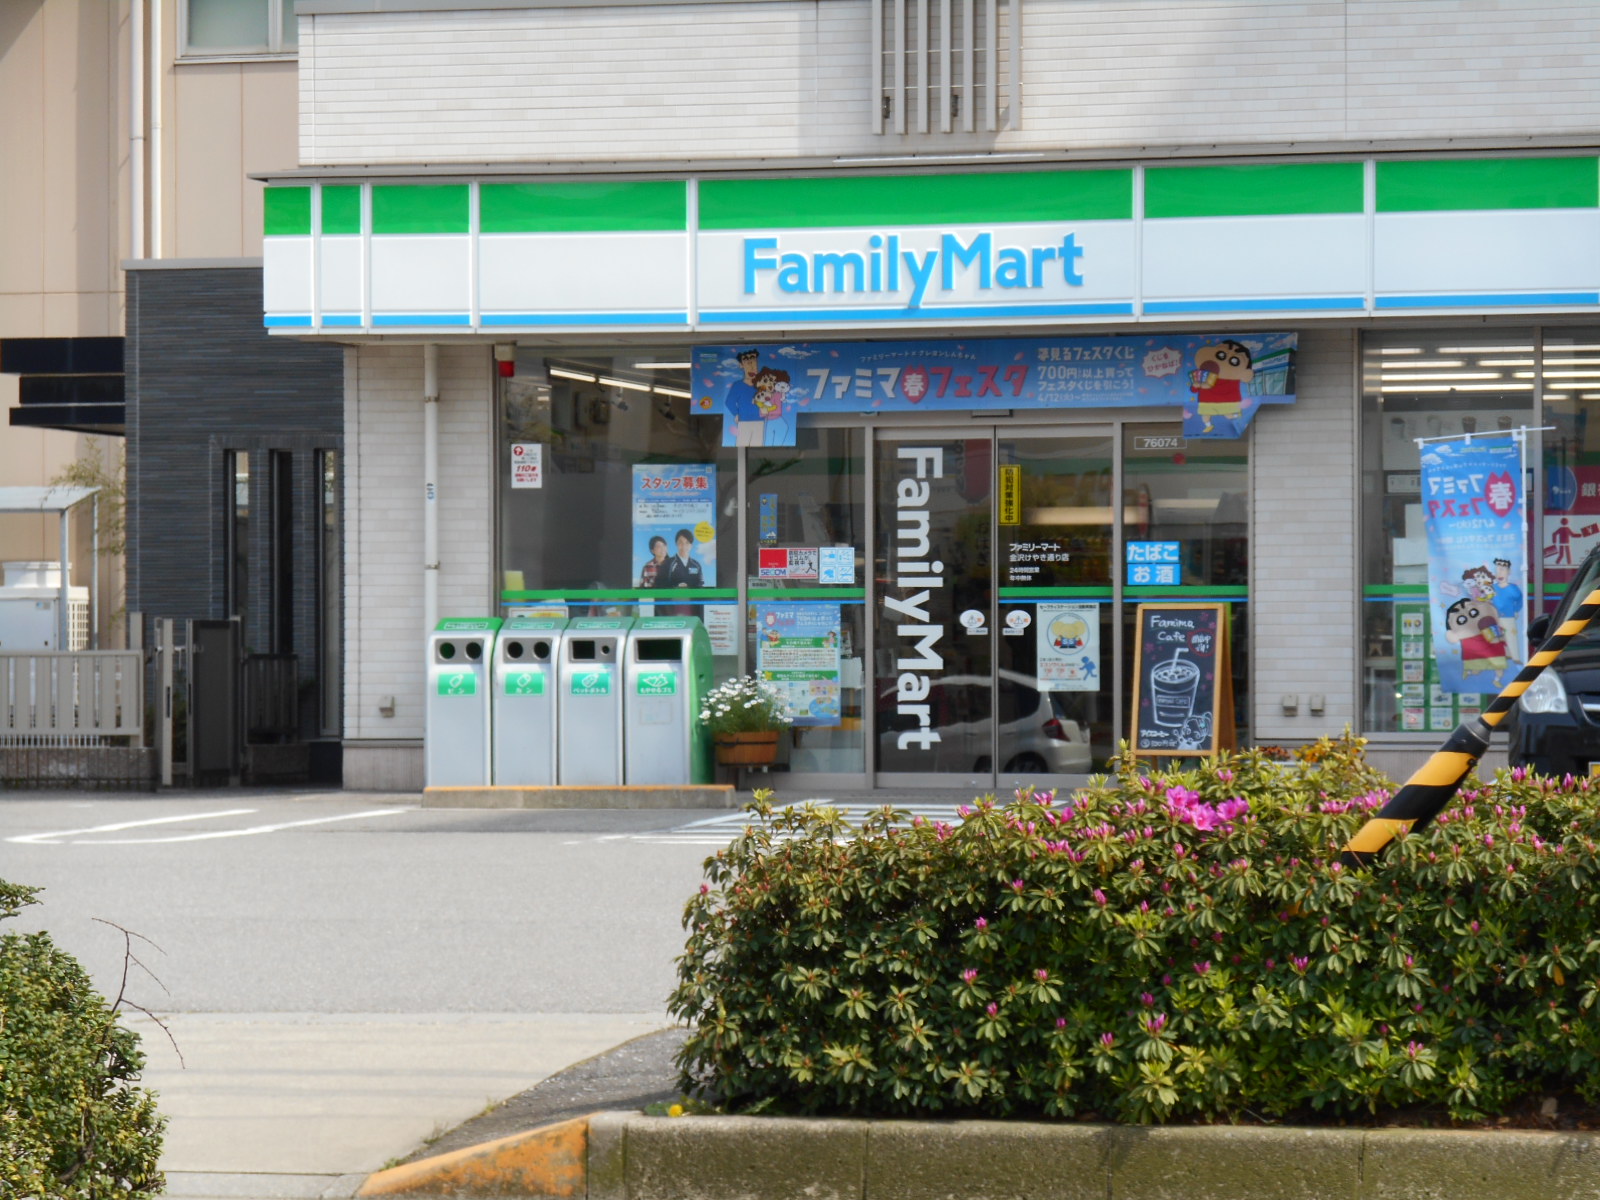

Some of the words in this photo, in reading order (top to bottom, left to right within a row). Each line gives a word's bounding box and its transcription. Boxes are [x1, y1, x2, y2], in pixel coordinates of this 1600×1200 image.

[743, 232, 1084, 309] FamilyMart
[1143, 437, 1178, 448] 76074
[641, 475, 709, 489] スタッフ募集
[1581, 483, 1600, 497] 銀
[1009, 543, 1061, 552] ファミリーマート
[1127, 544, 1179, 562] たばこ
[1009, 553, 1070, 562] 金沢けやき通り店
[1134, 565, 1174, 584] お酒
[885, 448, 944, 750] FamilyMart
[1150, 615, 1195, 629] Famima
